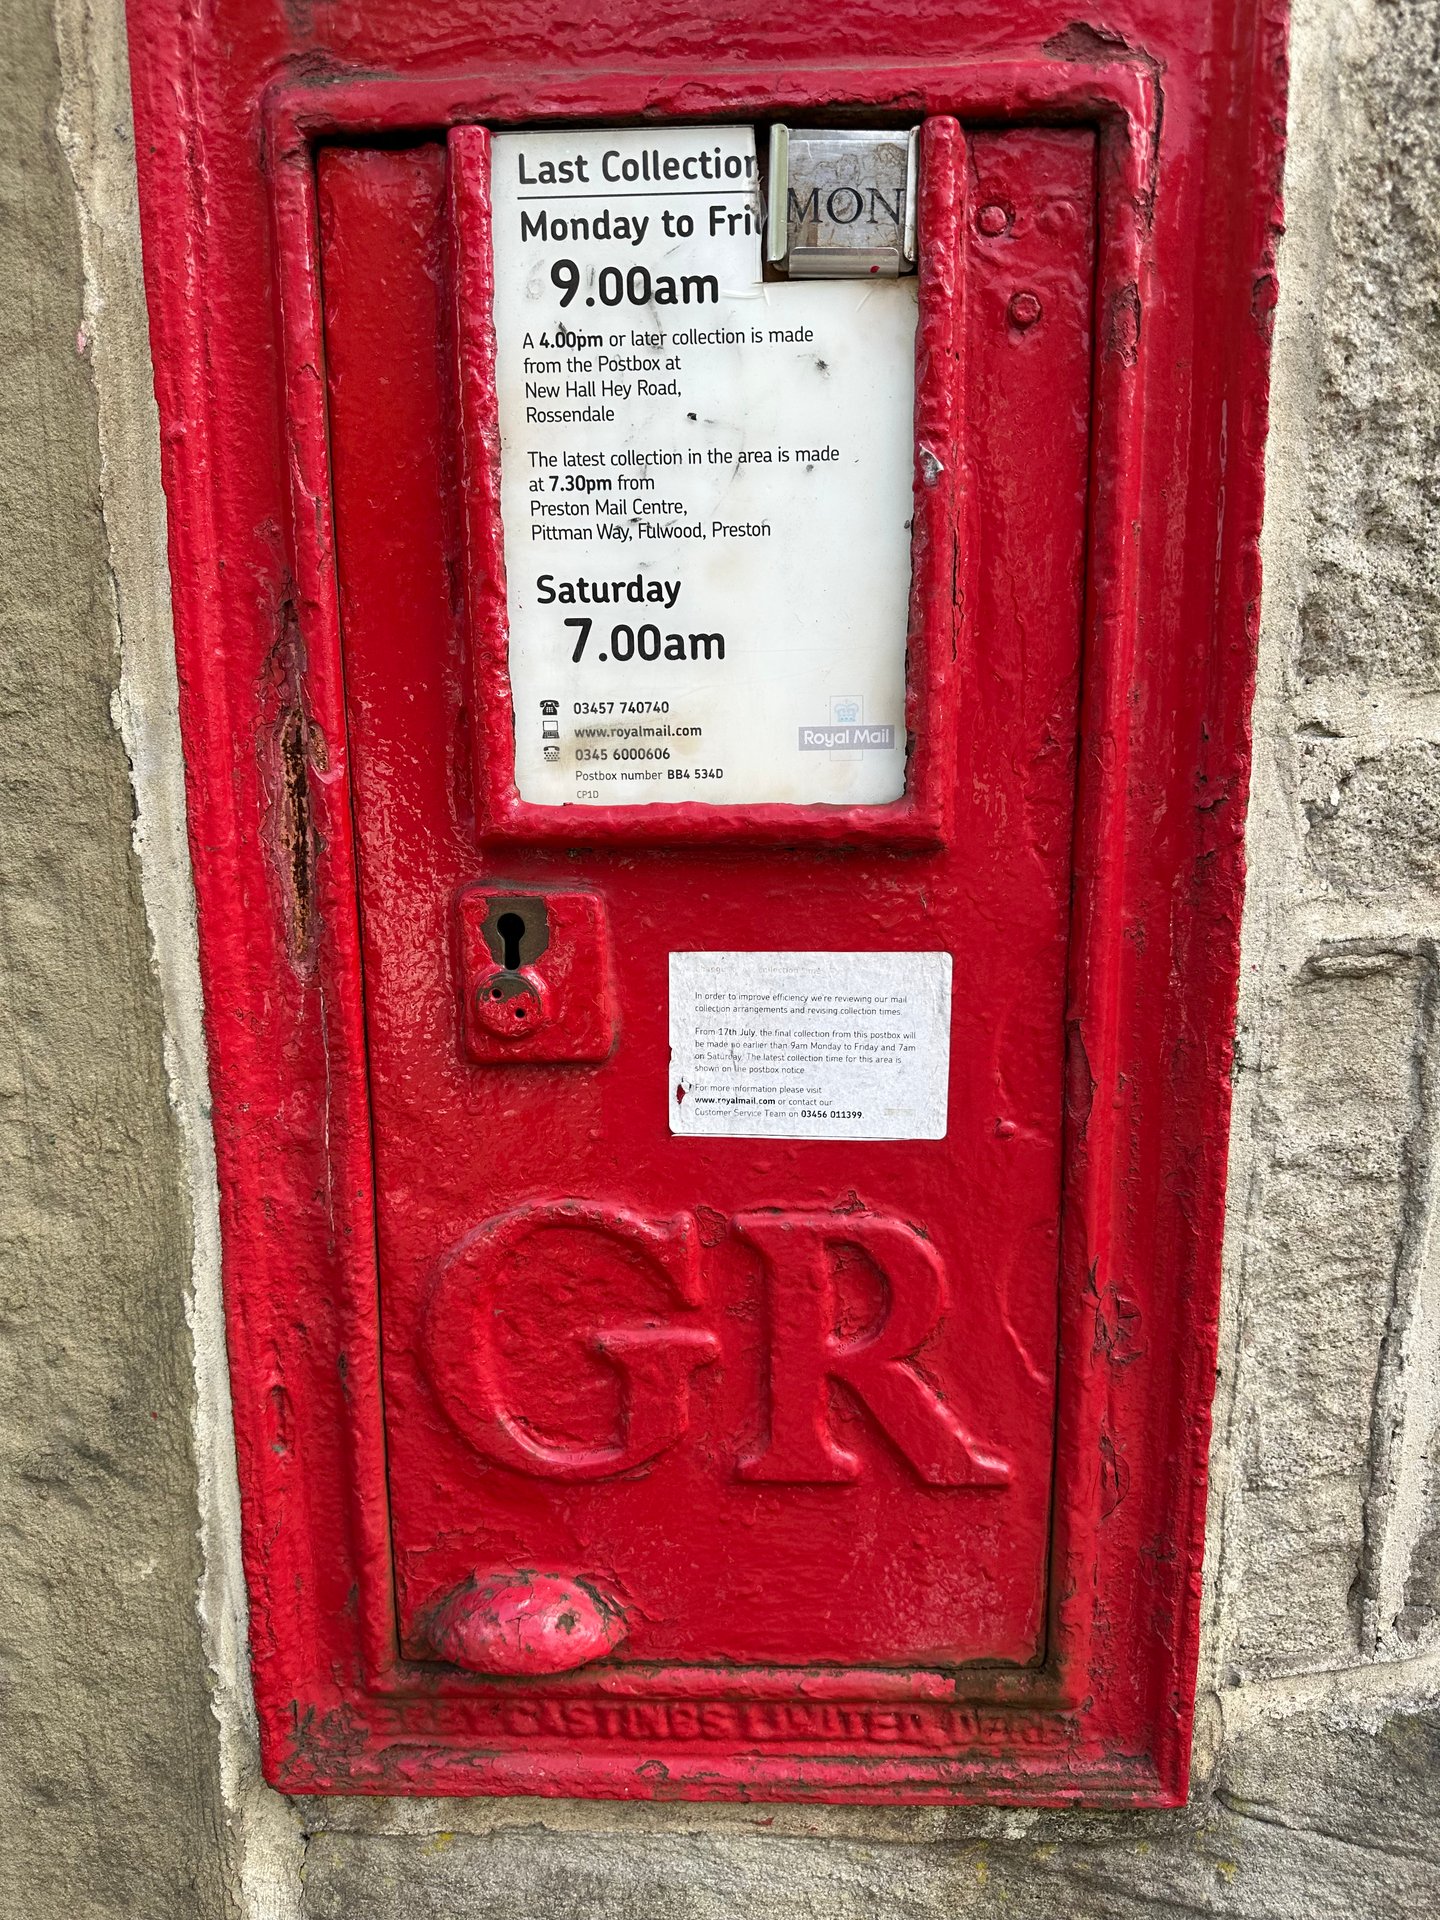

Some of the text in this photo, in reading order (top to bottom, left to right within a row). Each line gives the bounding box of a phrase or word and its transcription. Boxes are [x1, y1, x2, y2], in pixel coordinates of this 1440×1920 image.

[519, 153, 589, 184] Last
[788, 187, 906, 225] MON
[521, 209, 649, 246] Monday
[661, 210, 693, 237] to
[551, 259, 718, 307] 9.00am
[523, 326, 813, 351] A 4.00pm or later collection is made
[524, 355, 681, 373] from the Postbox at
[526, 379, 681, 400] New Hall Hey Road,
[527, 406, 614, 423] Rossendale
[527, 445, 839, 467] The latest collection in the area is made
[529, 475, 654, 494] at 7.30pm from
[531, 499, 687, 516] Preston Mail Centre,
[532, 522, 770, 542] Pittman Way, Fulwood, Preston
[537, 574, 681, 609] Saturday
[564, 618, 724, 663] 7.00am
[574, 701, 669, 714] 03457 740740
[574, 725, 701, 739] www.royalmail.com
[804, 727, 890, 748] Royal Mail
[575, 748, 670, 761] 0345 6000606
[576, 769, 723, 780] Postbox number BB4 534D
[773, 993, 808, 1004] efficiency
[835, 996, 871, 1004] reviewing
[808, 1008, 837, 1016] revising
[695, 1027, 715, 1035] From
[775, 1029, 791, 1037] final
[791, 1041, 807, 1049] 9am
[811, 1042, 841, 1051] Monday
[855, 1043, 878, 1052] Friday
[747, 1053, 761, 1061] The
[859, 1055, 873, 1063] this
[733, 1085, 777, 1093] information
[780, 1086, 804, 1094] please
[695, 1097, 775, 1105] www.royalmail.com
[695, 1108, 731, 1117] Customer
[734, 1109, 761, 1117] Service
[765, 1109, 786, 1117] Team
[801, 1110, 827, 1118] 03456
[831, 1111, 864, 1119] 011399.
